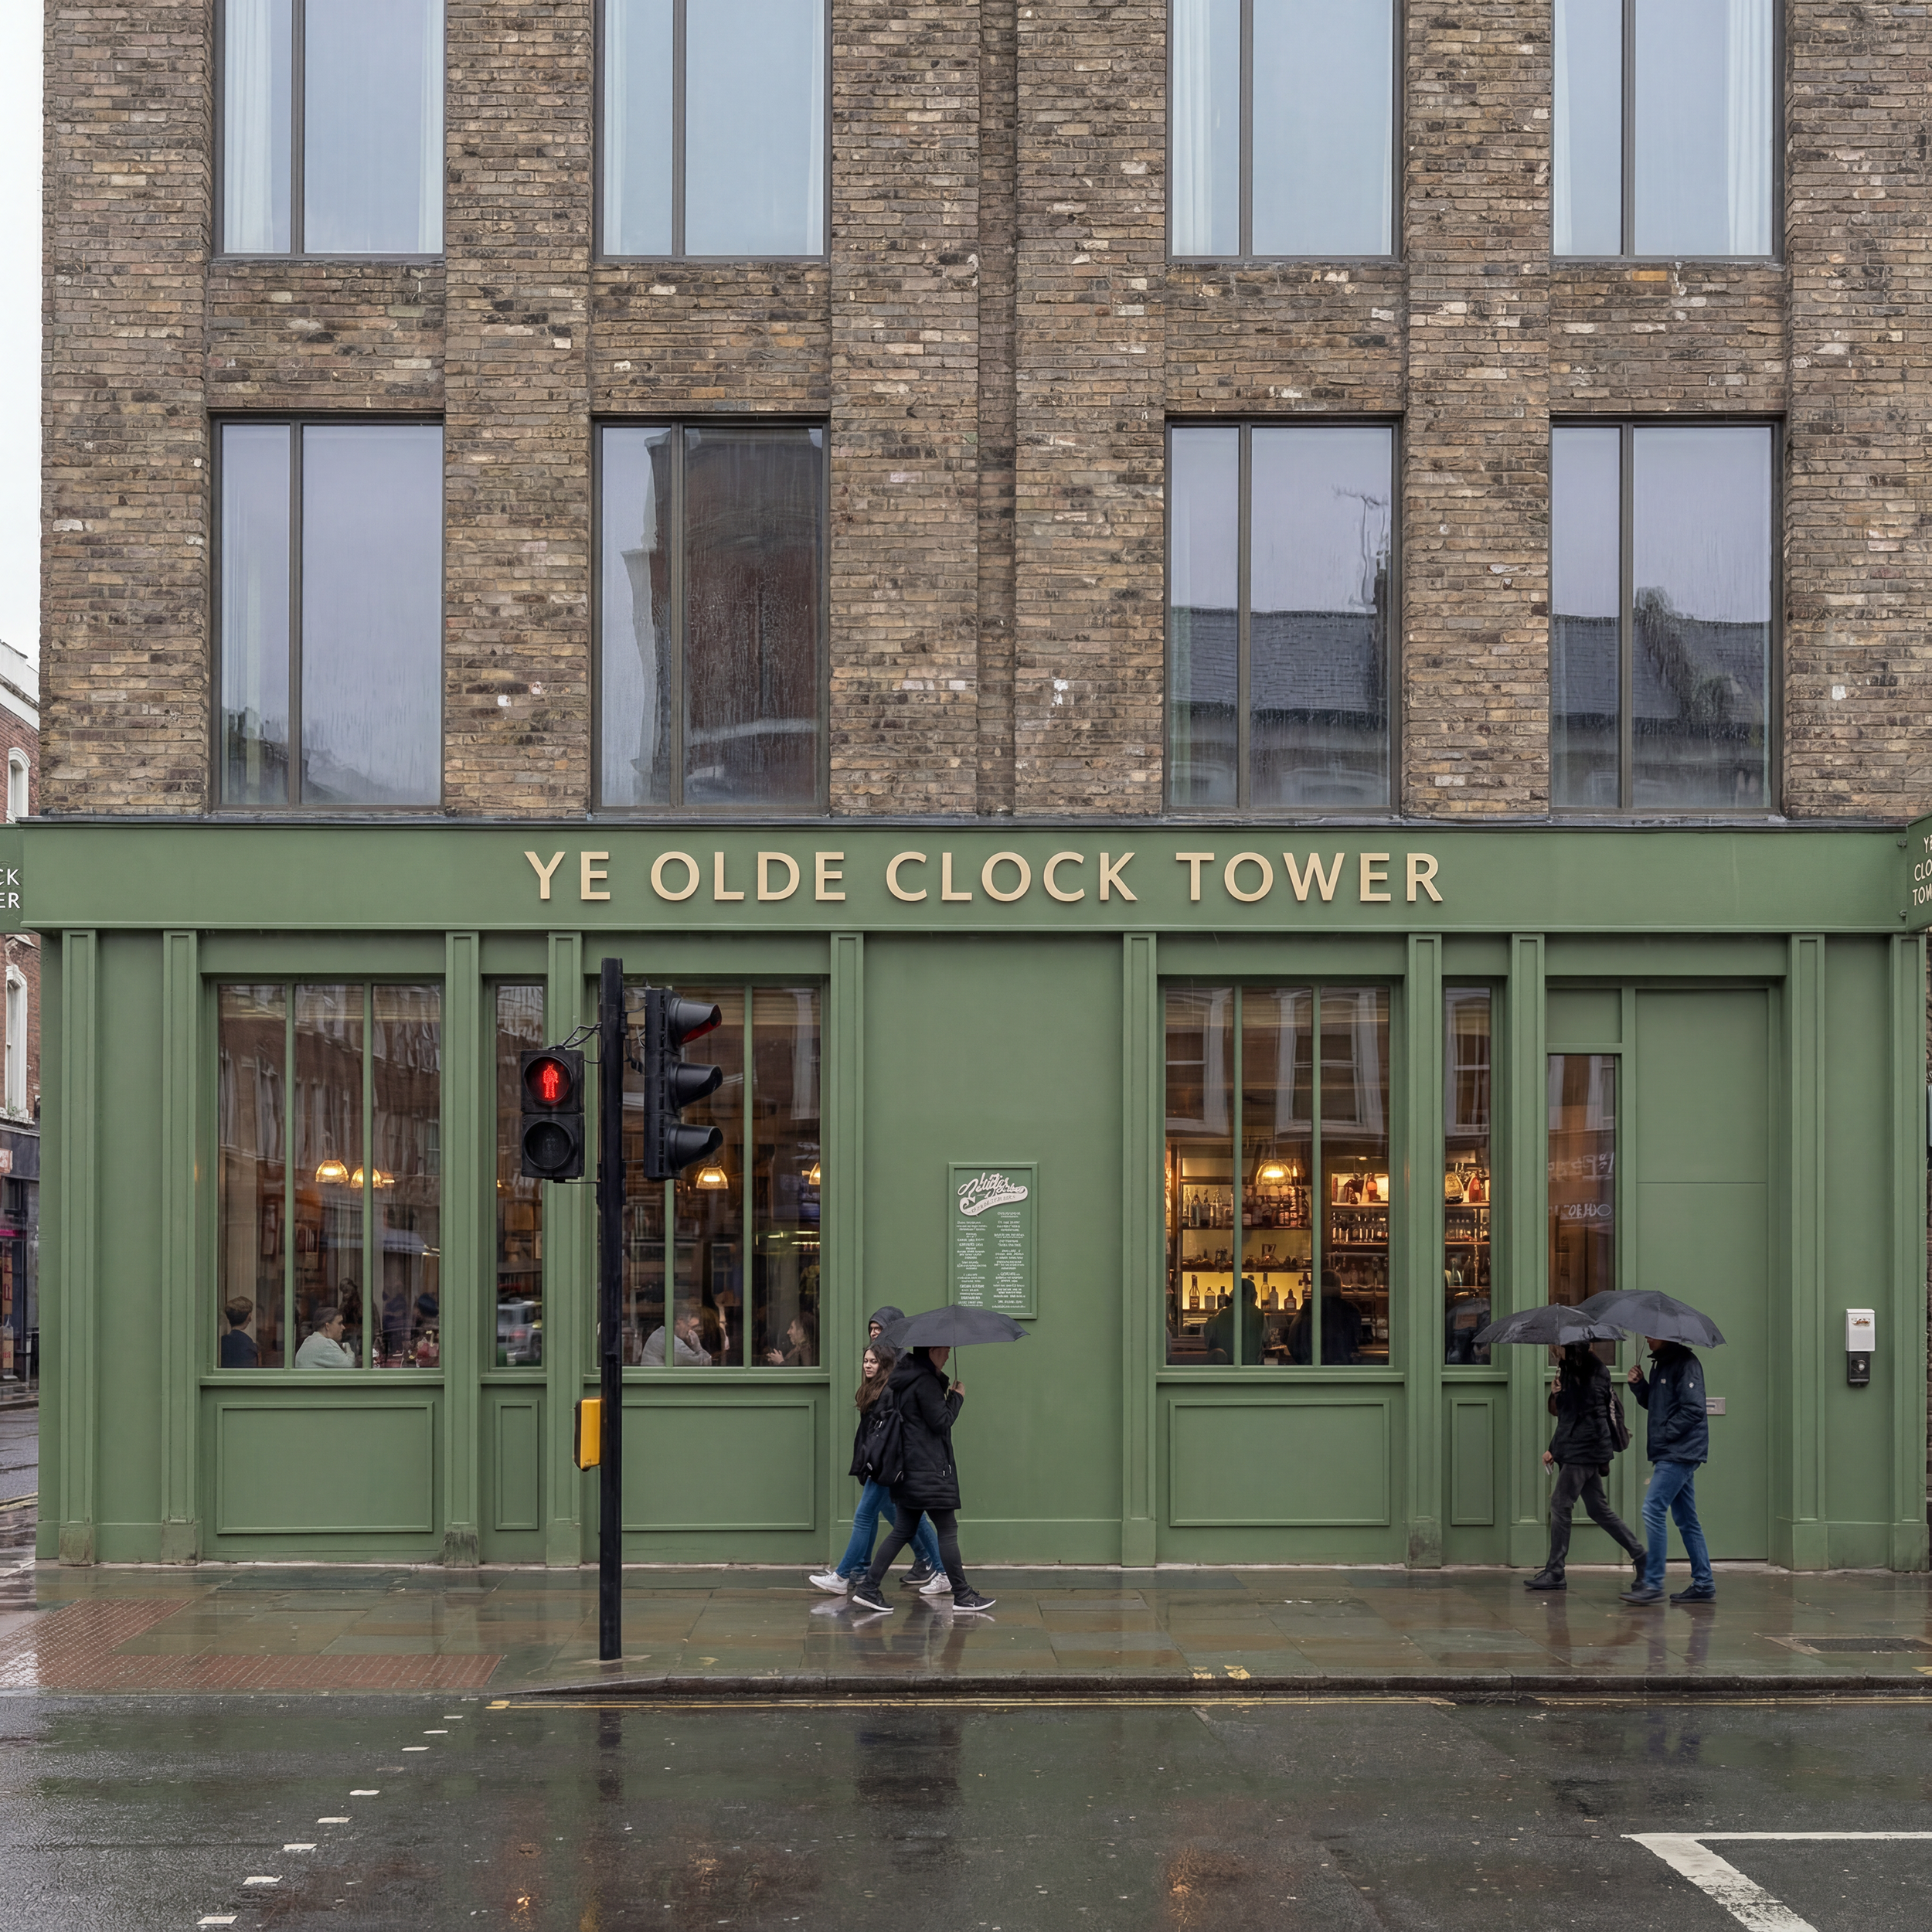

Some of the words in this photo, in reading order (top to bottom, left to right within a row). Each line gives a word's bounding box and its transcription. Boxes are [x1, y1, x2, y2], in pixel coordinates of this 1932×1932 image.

[524, 851, 611, 900] YE
[650, 851, 846, 901] OLDE
[886, 851, 1139, 902] CLOCK
[1175, 852, 1444, 902] TOWER
[1913, 859, 1932, 882] CLO
